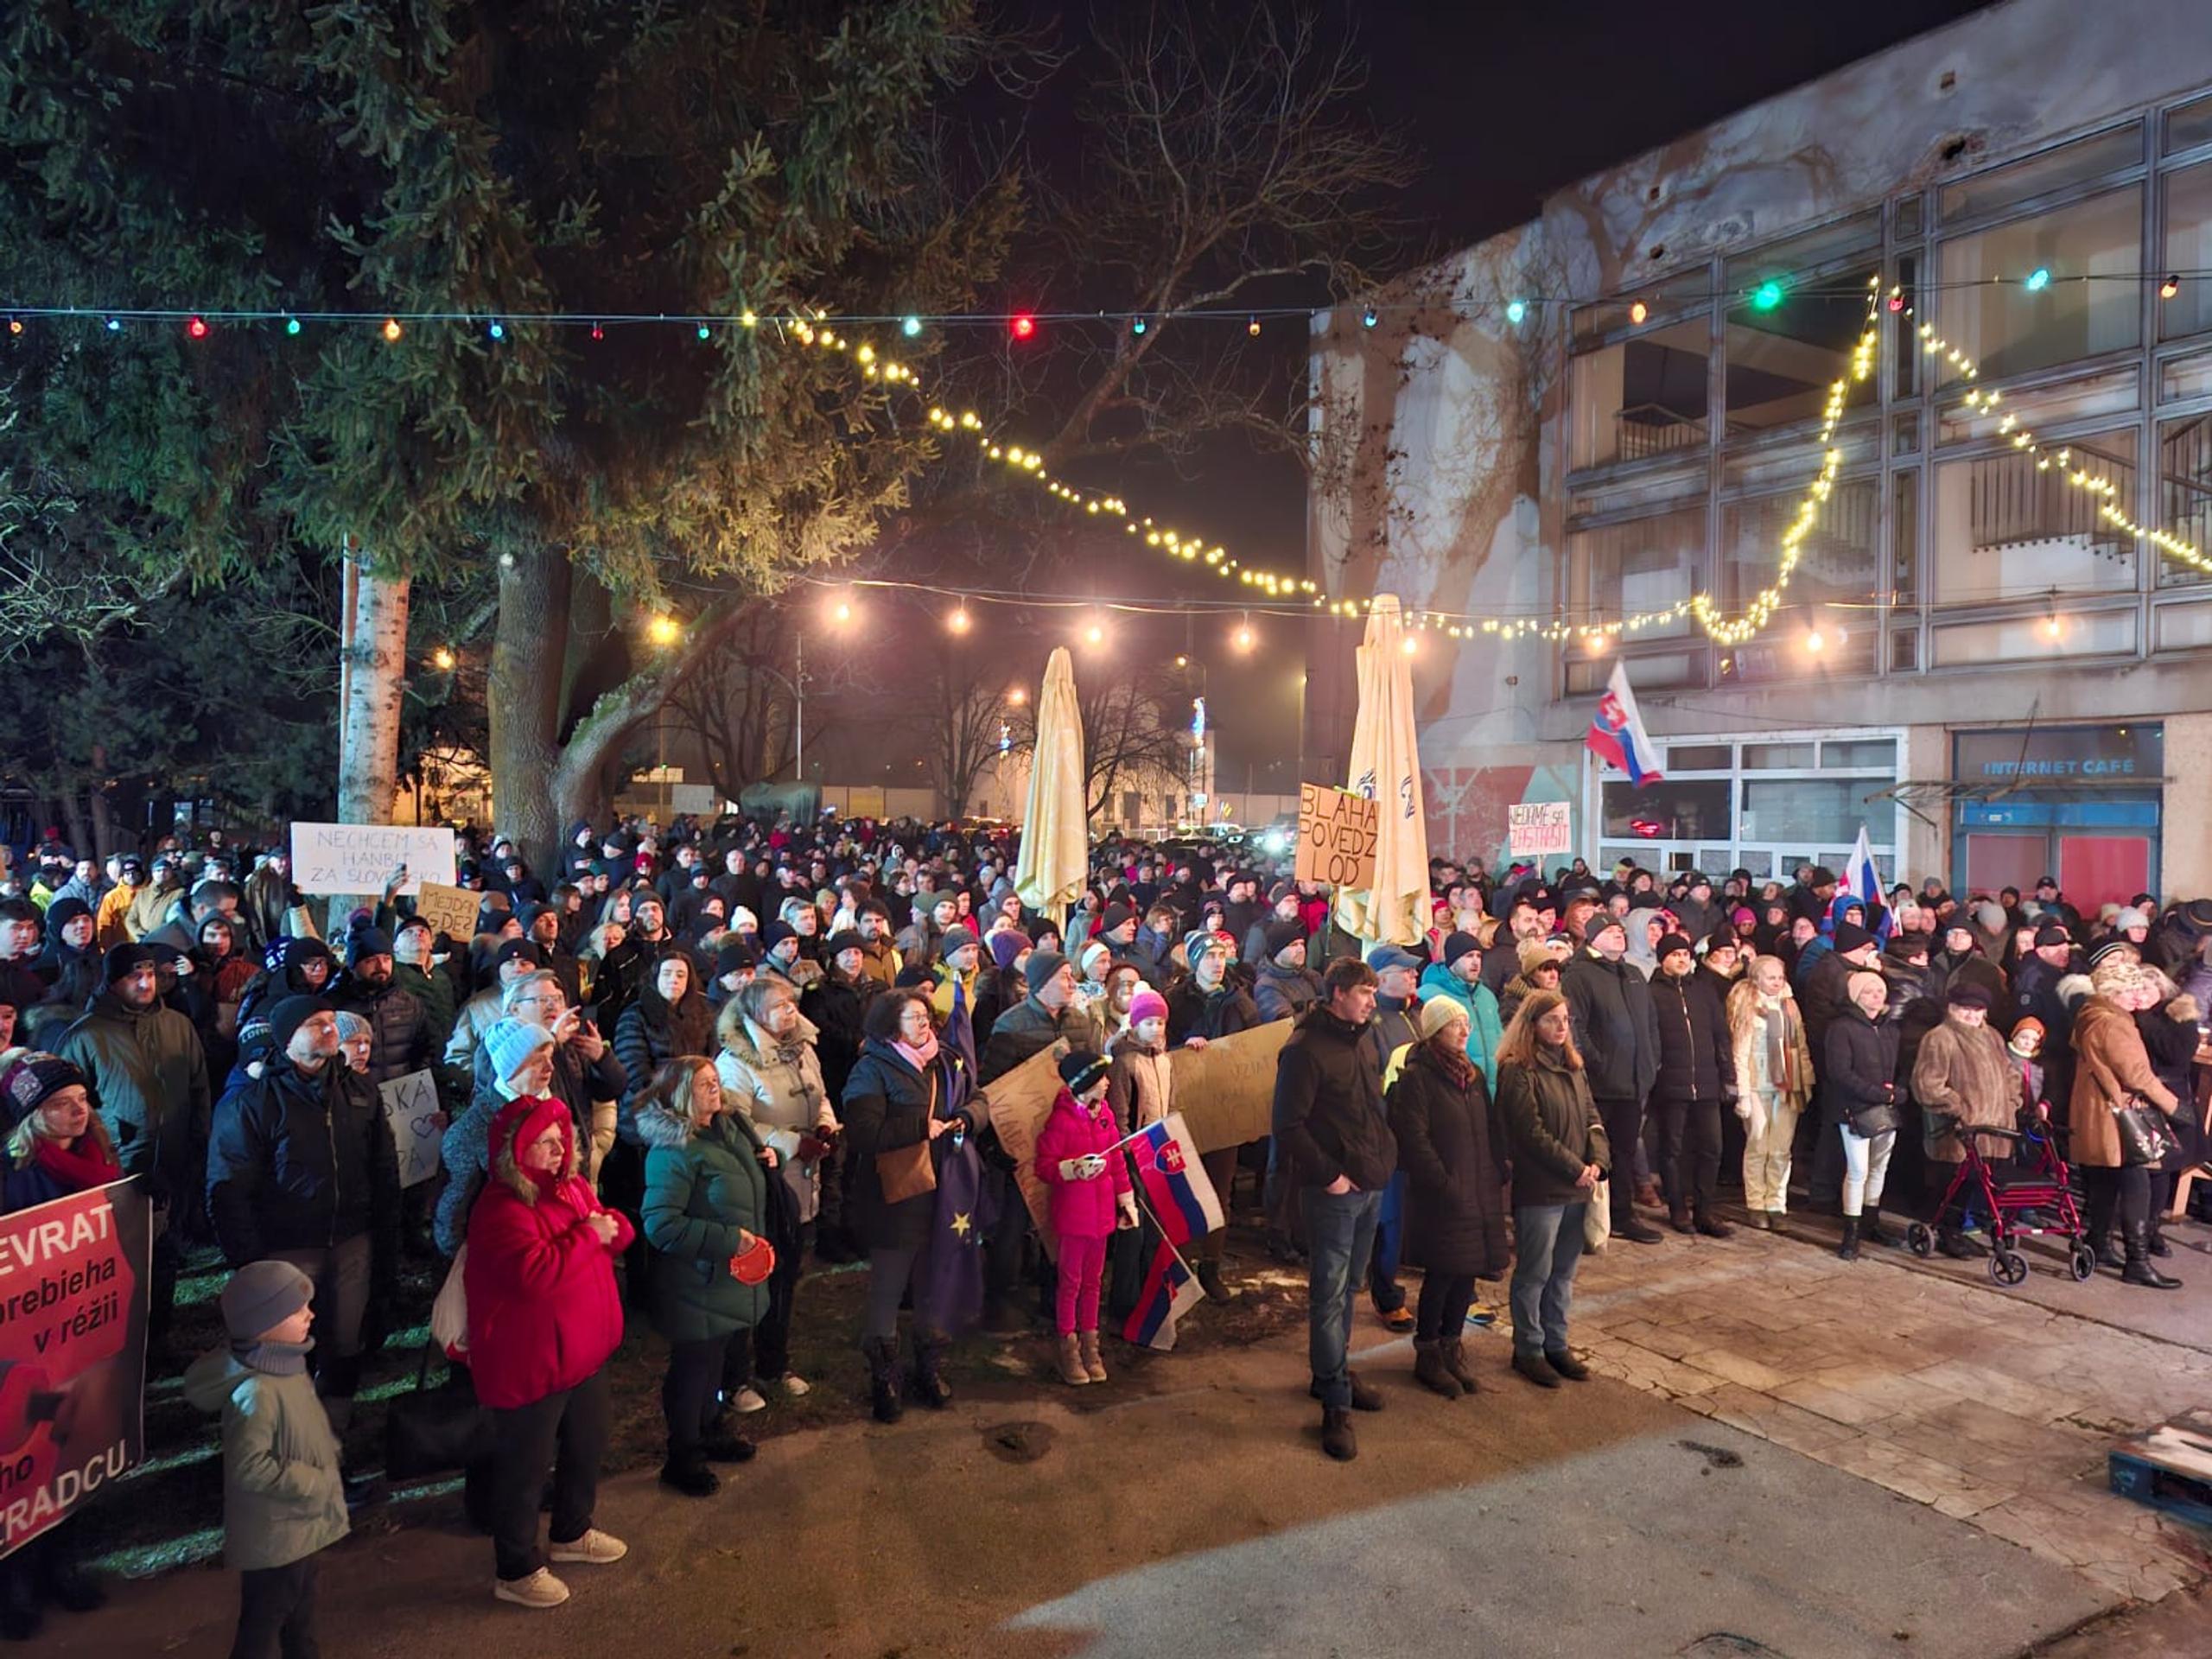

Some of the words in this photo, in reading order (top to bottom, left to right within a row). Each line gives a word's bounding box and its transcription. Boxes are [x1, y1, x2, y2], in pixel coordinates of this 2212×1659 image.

[1983, 760, 2077, 775] INTERNET
[1300, 786, 1378, 830] BLAHA
[317, 830, 410, 849] NECHCEM
[417, 834, 438, 851] SA
[1299, 818, 1379, 858] POVEDZ
[310, 867, 339, 883] ZA
[347, 868, 442, 886] SLOVSKO
[0, 1256, 116, 1325] rebieha
[34, 1327, 52, 1354] v
[60, 1290, 118, 1344] réžii
[0, 1438, 133, 1547] RADCU.
